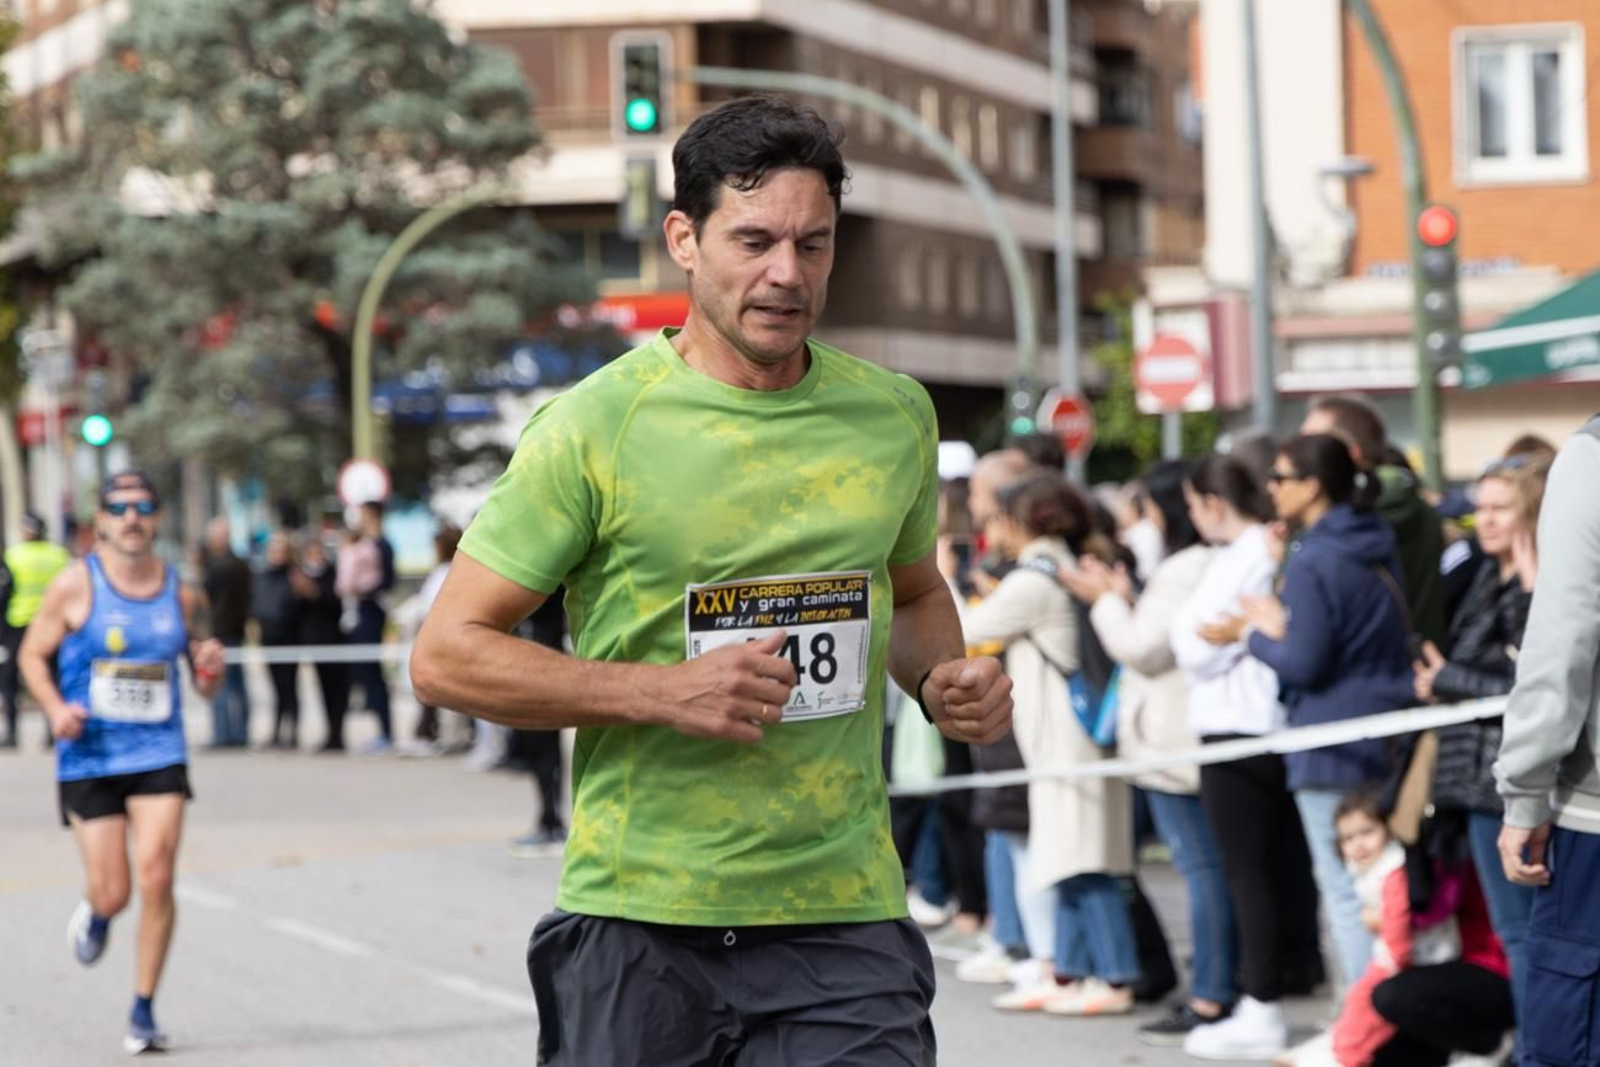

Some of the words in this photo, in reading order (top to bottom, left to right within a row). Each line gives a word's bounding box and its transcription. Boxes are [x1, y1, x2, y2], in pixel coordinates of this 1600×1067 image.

[695, 589, 737, 614] XXV
[739, 583, 803, 599] CARRERA
[806, 580, 863, 594] POPULAR
[740, 600, 749, 612] y
[758, 597, 795, 611] gran
[802, 591, 863, 605] caminata
[737, 615, 753, 627] LA
[785, 612, 799, 624] LA
[747, 632, 838, 685] 48
